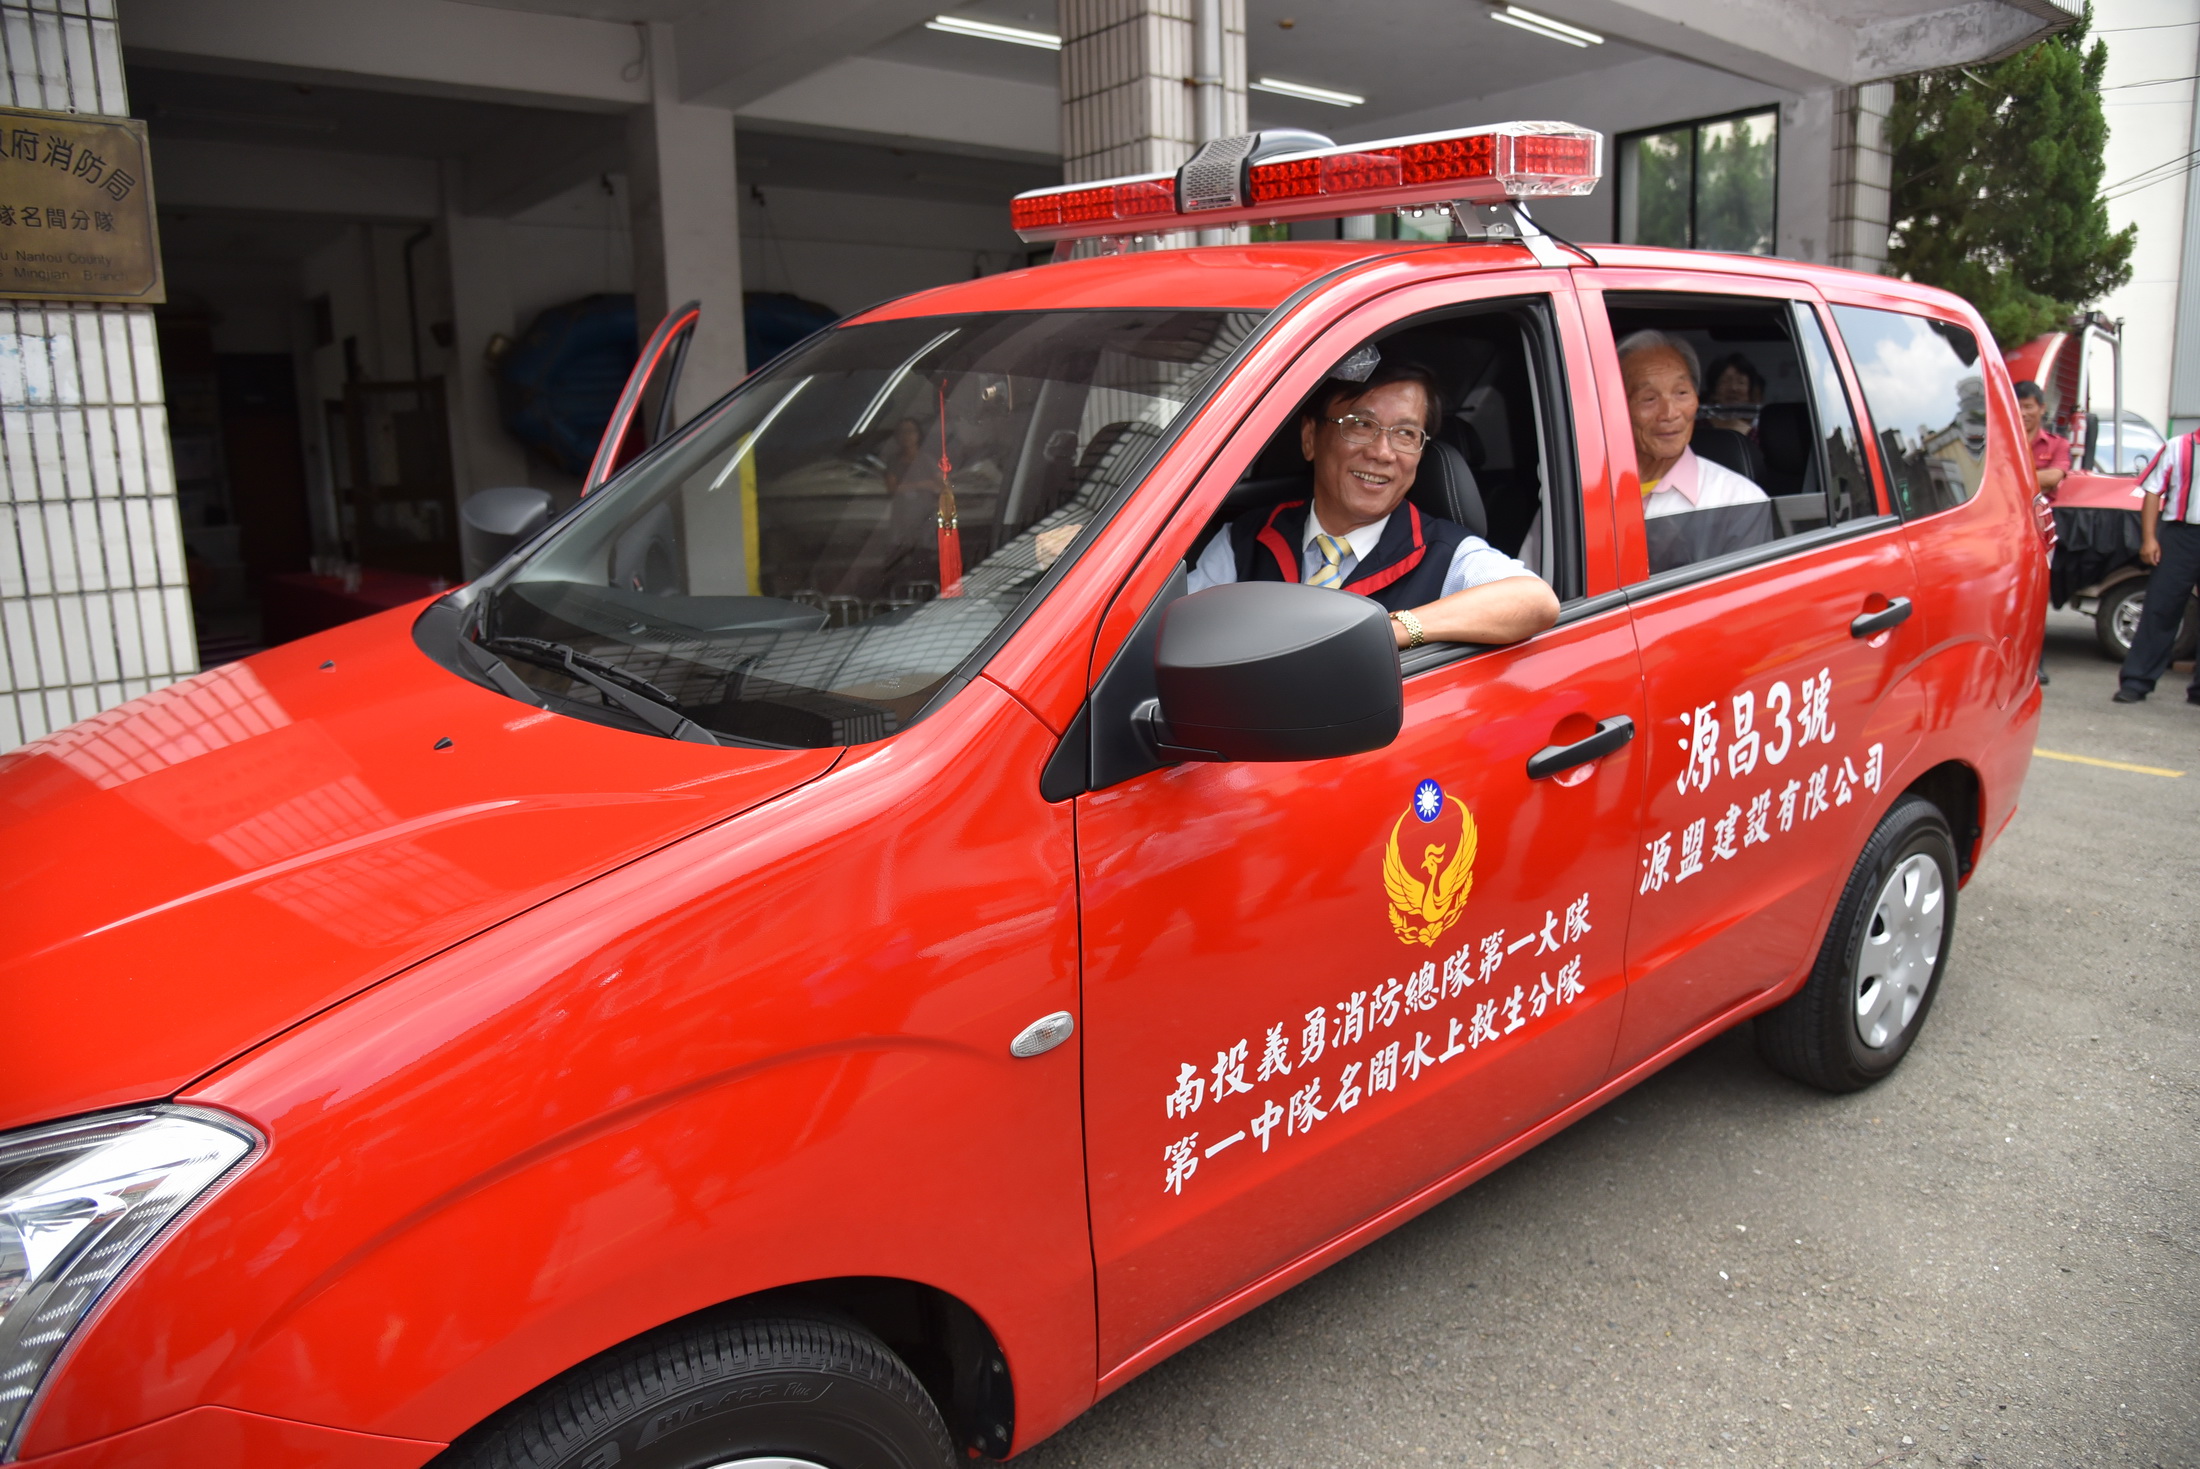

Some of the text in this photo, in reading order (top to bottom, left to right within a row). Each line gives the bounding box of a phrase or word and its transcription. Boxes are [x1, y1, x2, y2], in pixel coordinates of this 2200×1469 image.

[14, 267, 70, 281] Mingjian
[16, 250, 63, 264] Nantou
[68, 252, 112, 267] County
[1677, 667, 1835, 795] 源昌3號
[1640, 743, 1884, 895] 源盟建設有限公司
[1164, 954, 1585, 1195] 第一中隊名間水上救生分隊
[1166, 893, 1592, 1119] 南投義勇消防總隊第一大隊
